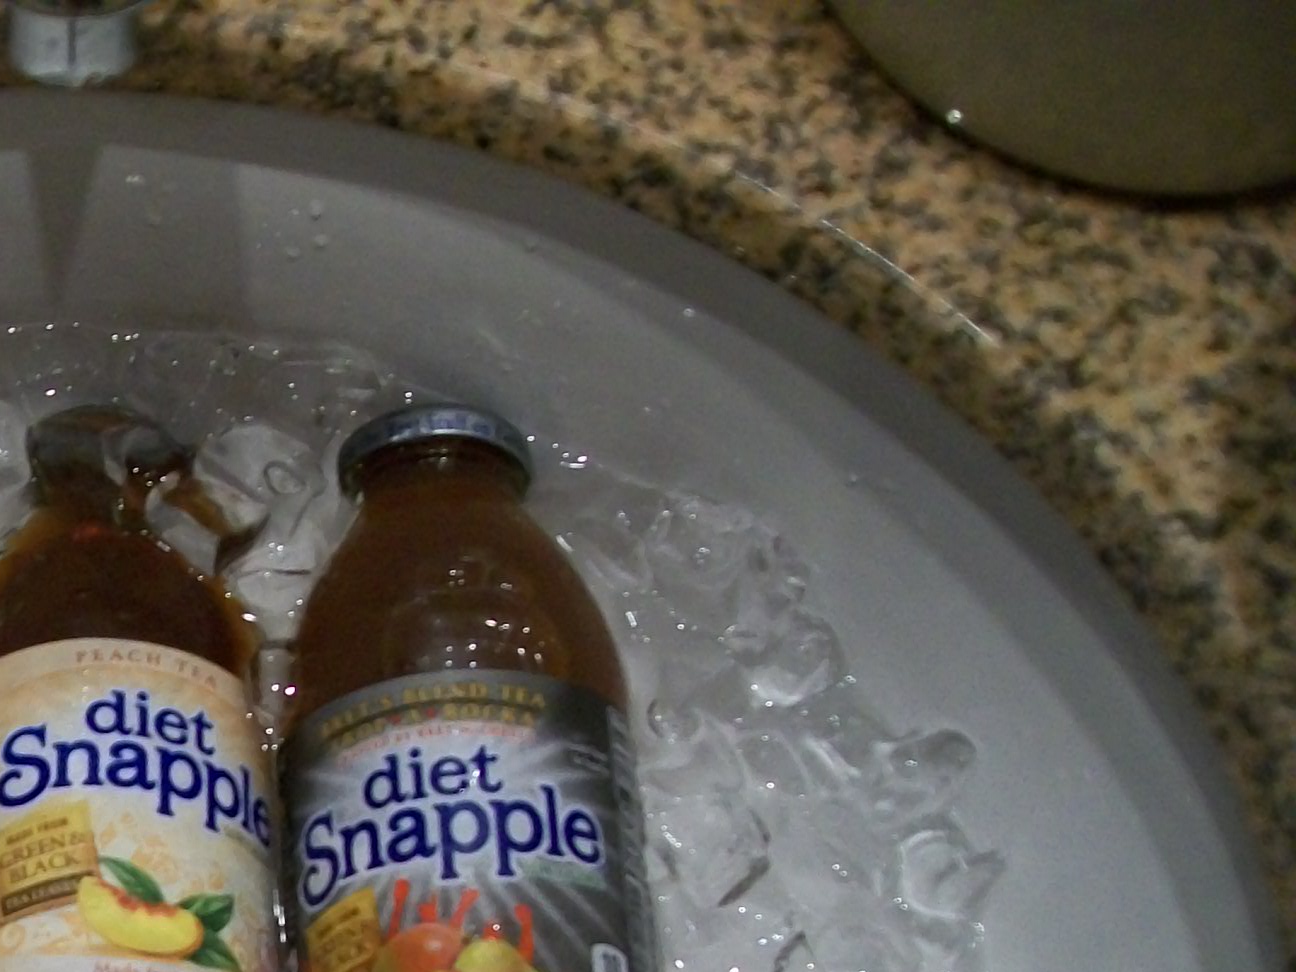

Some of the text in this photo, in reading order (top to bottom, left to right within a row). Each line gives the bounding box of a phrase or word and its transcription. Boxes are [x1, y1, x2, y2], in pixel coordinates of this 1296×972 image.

[76, 649, 217, 689] PEACH TEA
[86, 691, 215, 756] diet
[364, 746, 502, 808] diet
[8, 851, 80, 884] BLACK
[304, 786, 601, 906] Snapple
